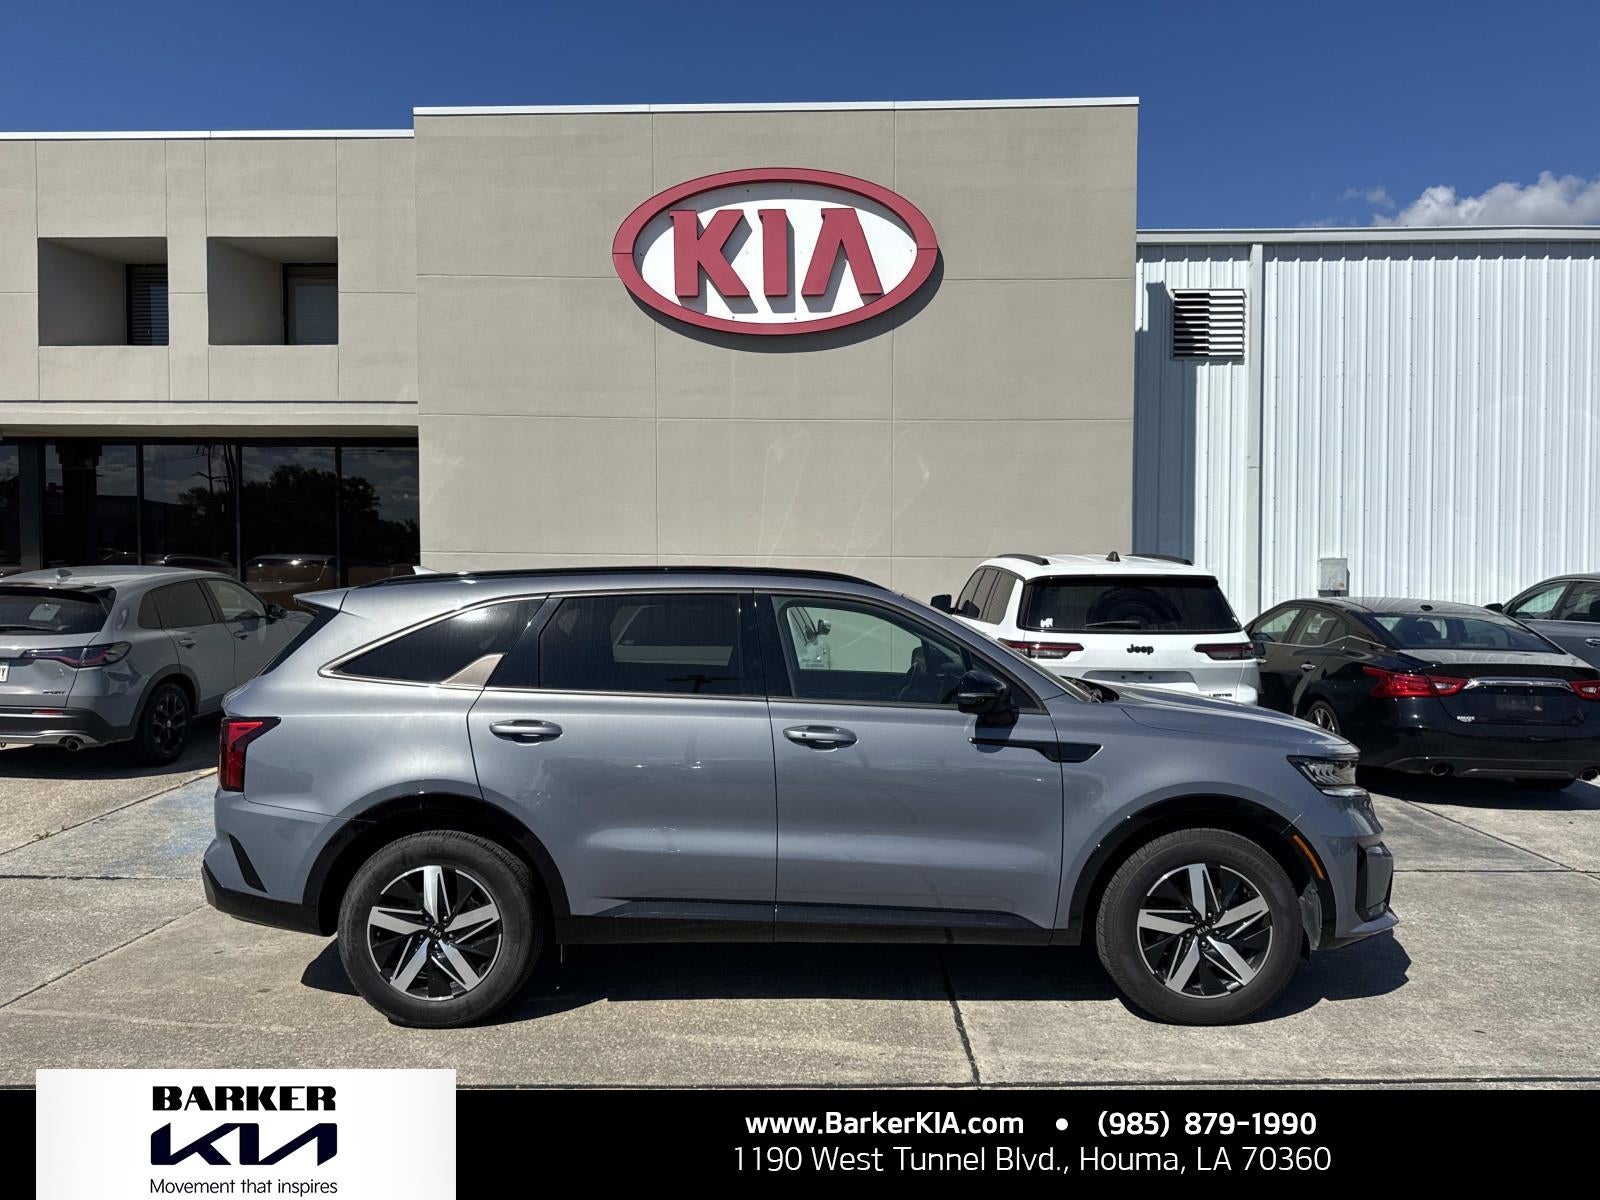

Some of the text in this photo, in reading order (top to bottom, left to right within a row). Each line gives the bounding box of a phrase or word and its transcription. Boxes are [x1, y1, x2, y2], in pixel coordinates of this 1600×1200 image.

[669, 208, 885, 297] KIA
[1126, 644, 1154, 655] Jeep
[428, 927, 442, 938] KIA
[1196, 925, 1210, 935] KIA
